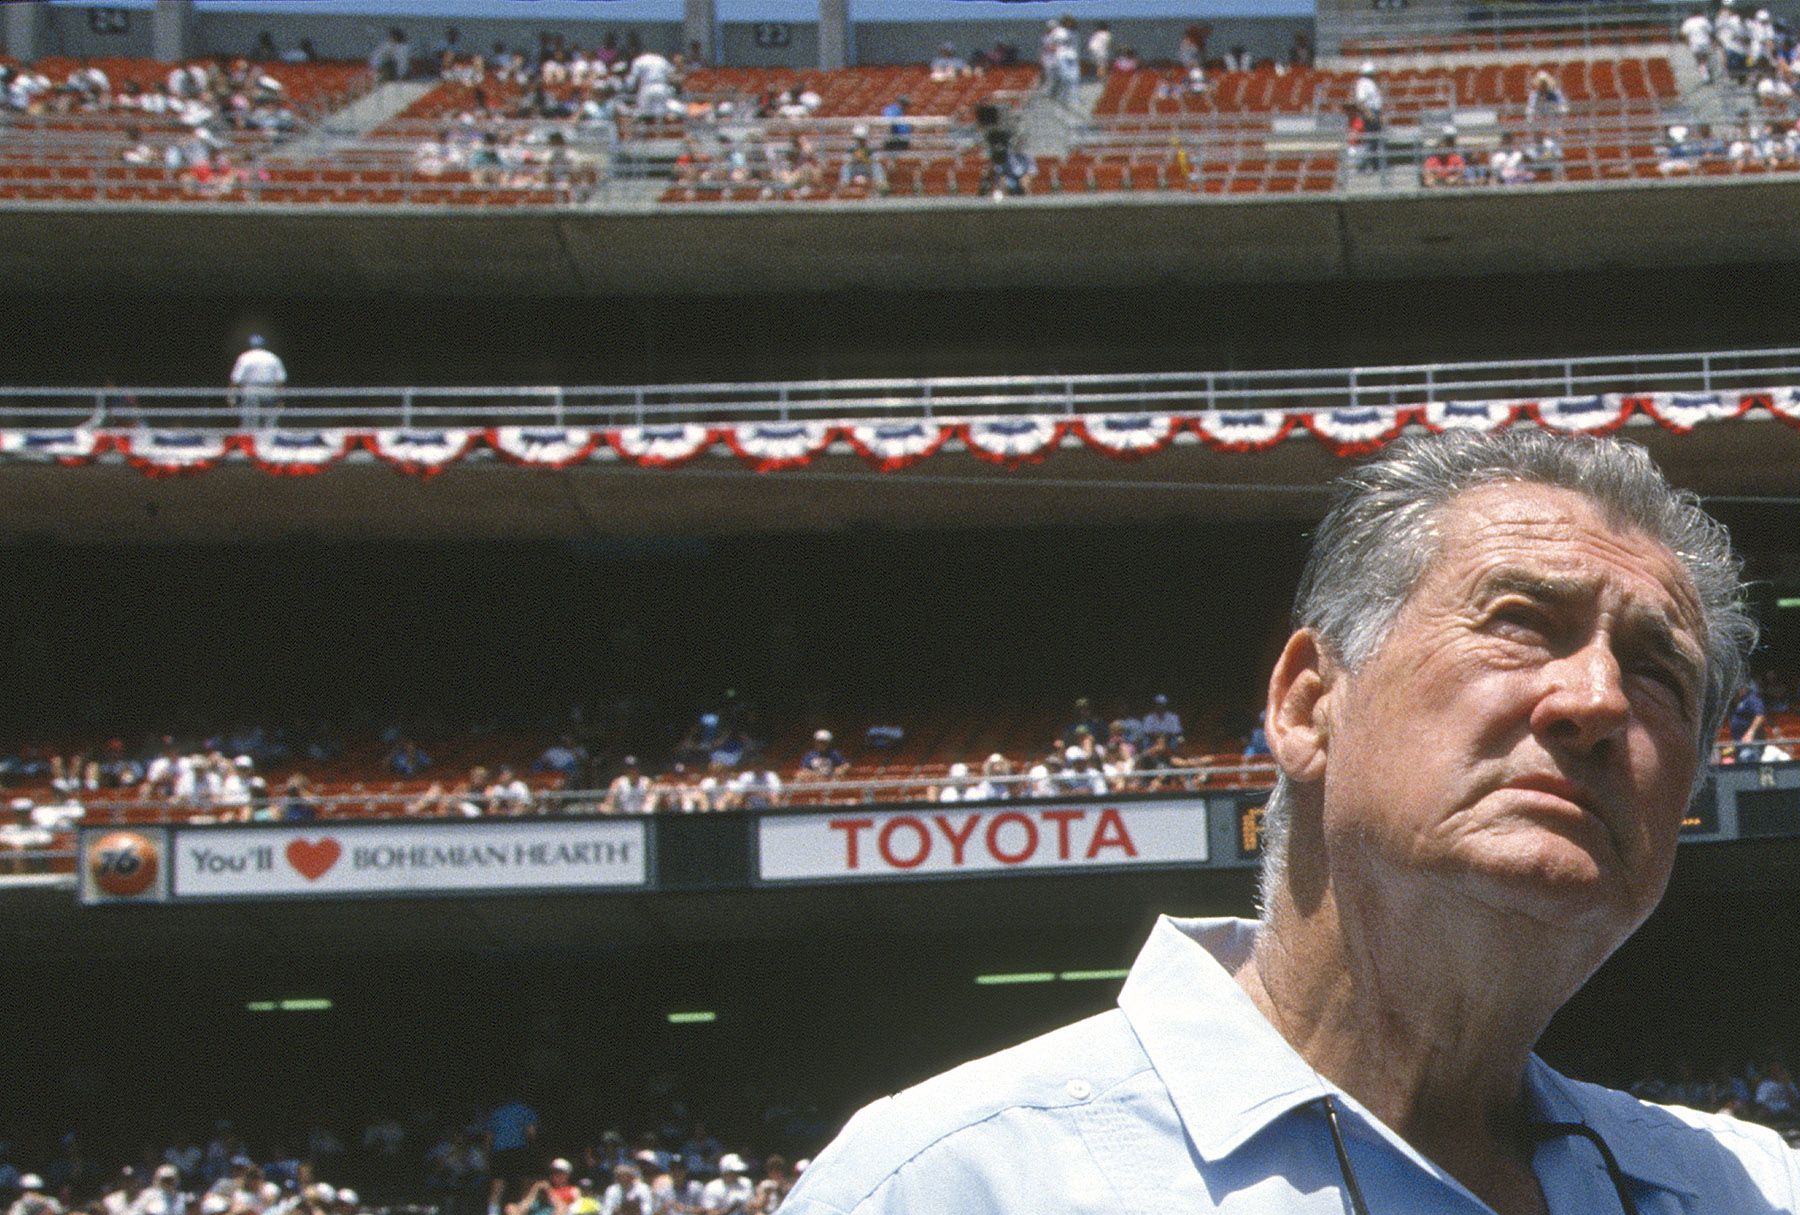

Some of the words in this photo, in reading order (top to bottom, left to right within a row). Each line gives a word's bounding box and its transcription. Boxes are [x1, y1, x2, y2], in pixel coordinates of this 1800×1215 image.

[829, 807, 1139, 869] TOYOTA
[96, 850, 140, 876] 76
[191, 846, 273, 873] You'll
[352, 845, 507, 870] BOHEMIAN
[514, 842, 630, 866] HEARTH
